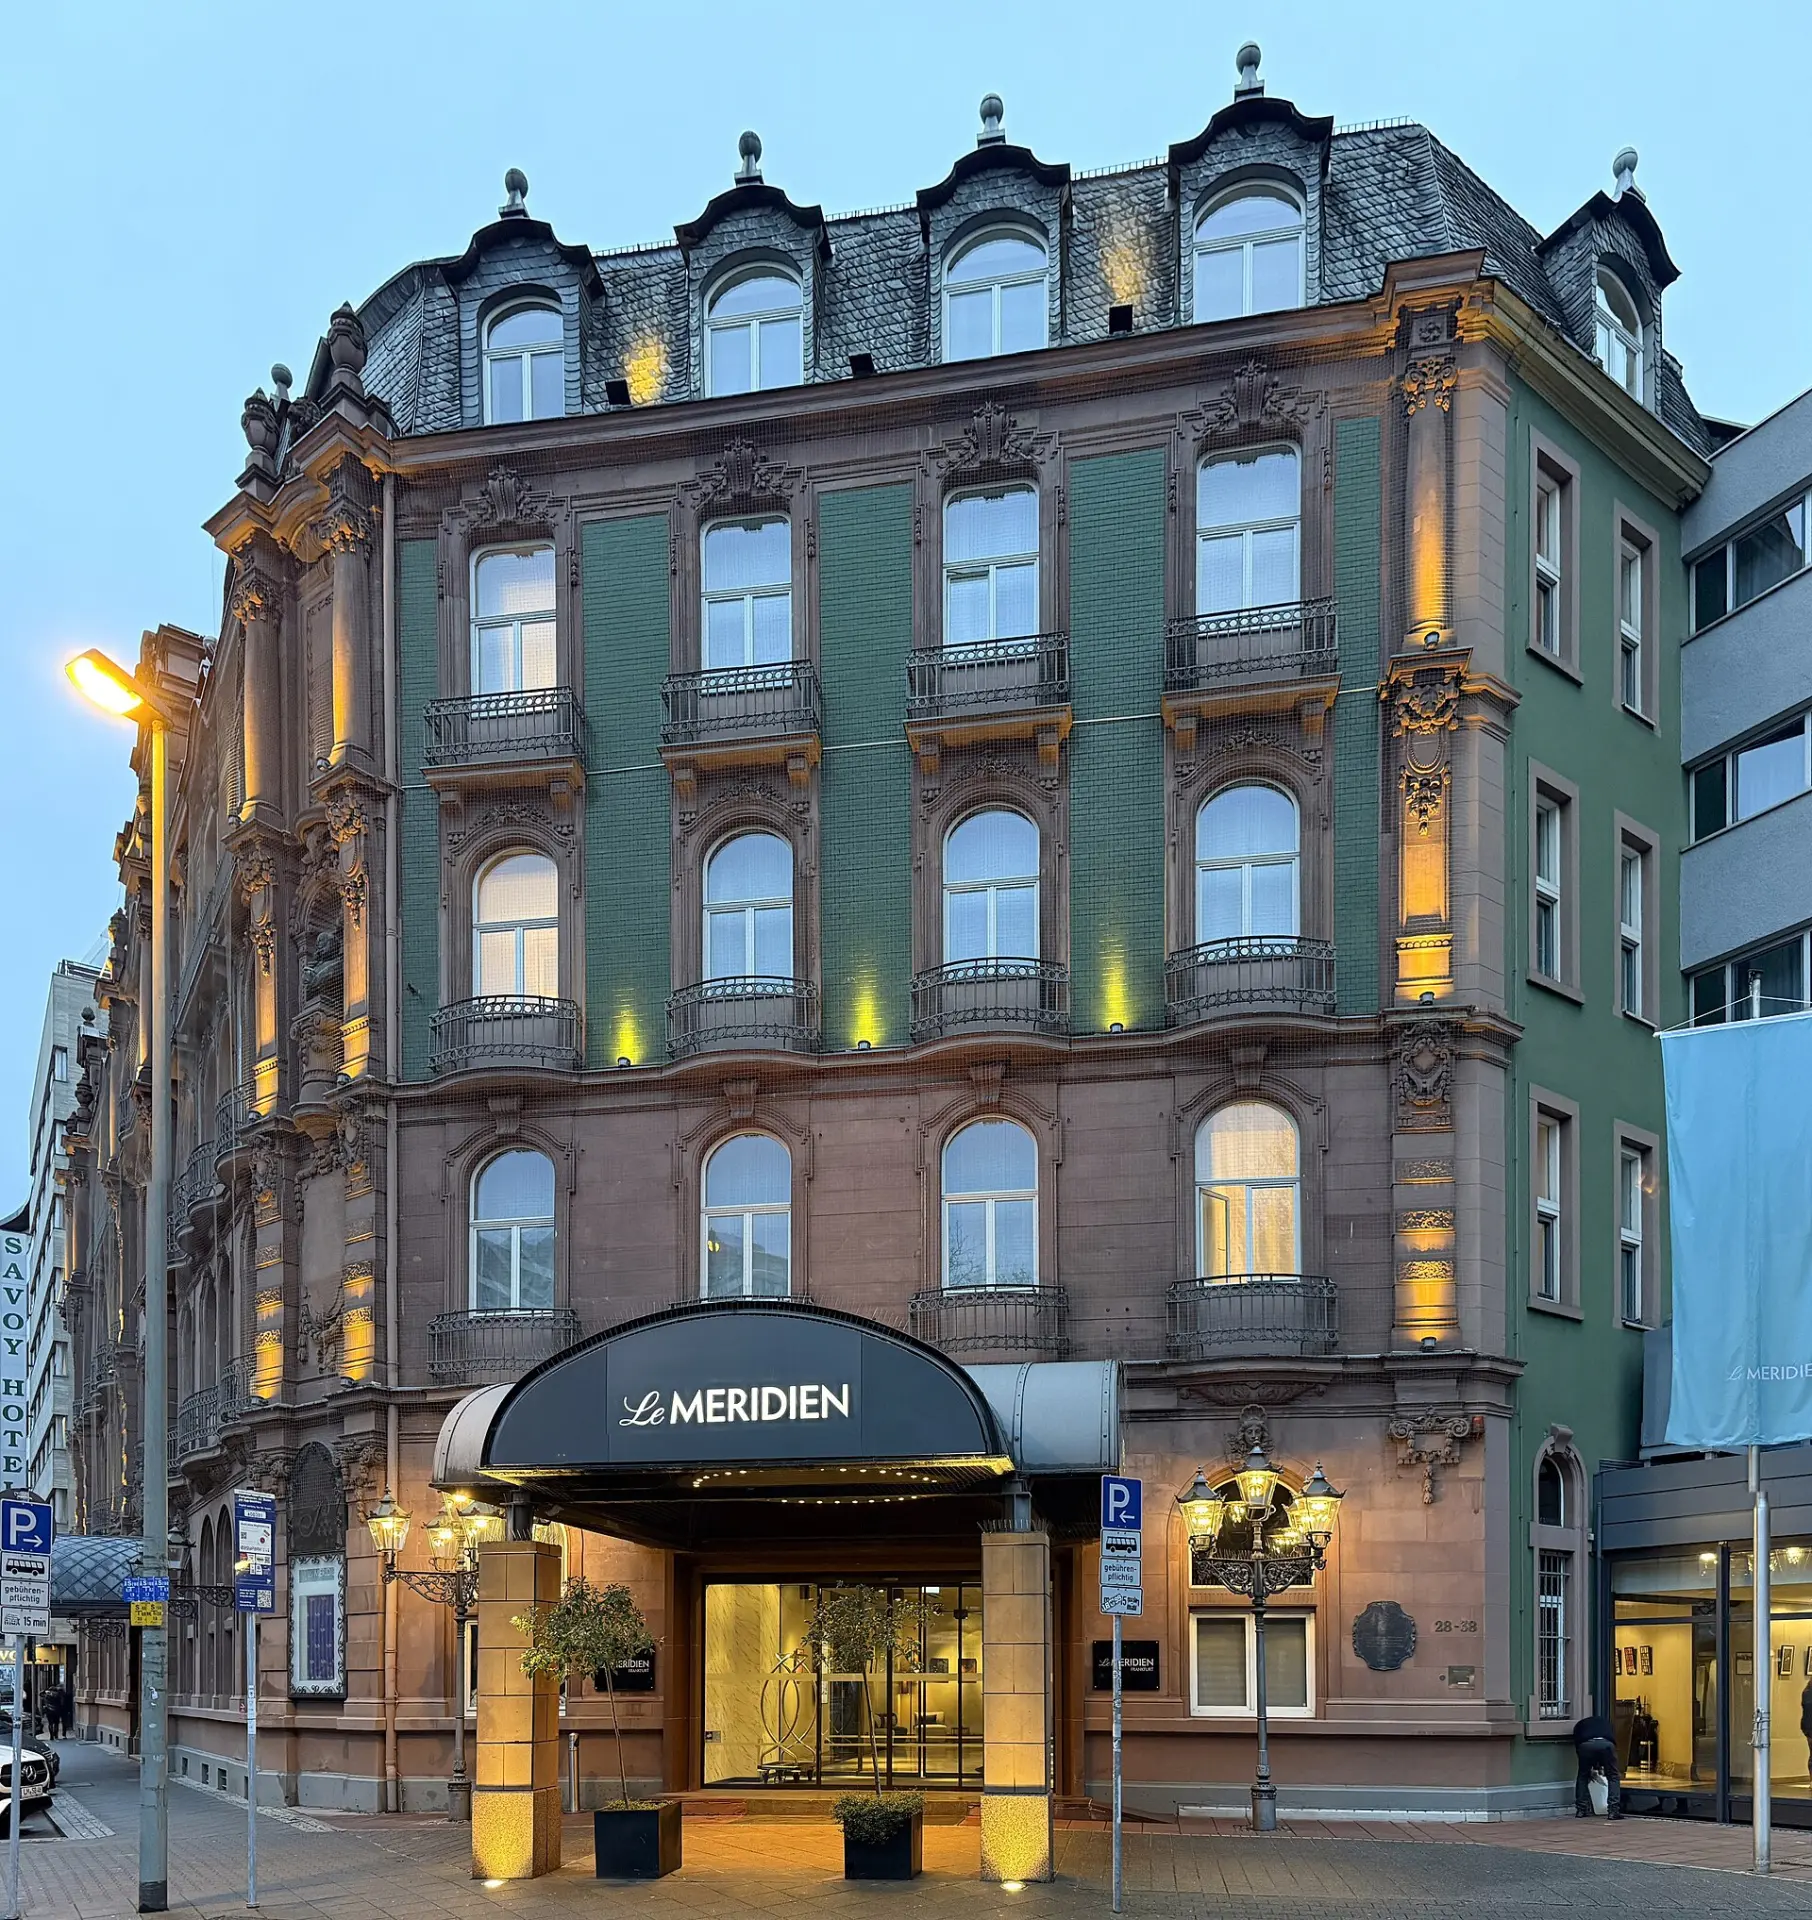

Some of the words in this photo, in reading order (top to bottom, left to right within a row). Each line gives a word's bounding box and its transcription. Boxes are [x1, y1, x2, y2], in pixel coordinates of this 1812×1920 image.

[3, 1236, 24, 1356] SAVOY
[619, 1390, 665, 1427] Le
[669, 1383, 849, 1425] MERIDIEN
[1109, 1483, 1130, 1522] P
[10, 1507, 37, 1546] P
[1104, 1564, 1137, 1573] gebühren-
[1107, 1571, 1134, 1582] pflichtig
[5, 1585, 44, 1595] gebühren-
[9, 1593, 40, 1604] pflichtig
[24, 1616, 31, 1626] 15
[33, 1616, 46, 1628] min
